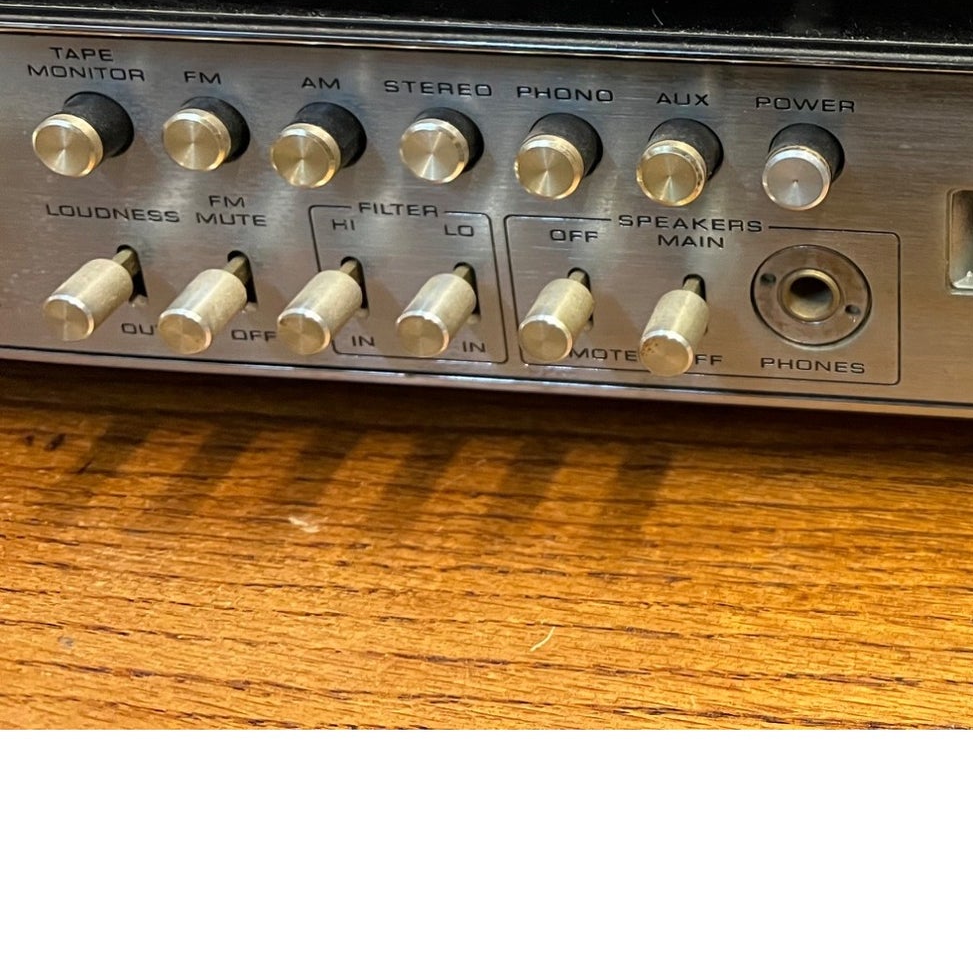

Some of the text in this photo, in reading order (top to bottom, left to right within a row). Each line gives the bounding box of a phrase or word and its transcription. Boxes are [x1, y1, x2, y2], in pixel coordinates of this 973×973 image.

[49, 46, 114, 63] TAPE
[27, 64, 146, 82] MONITOR
[183, 70, 222, 85] FM
[301, 76, 341, 91] AM
[384, 80, 493, 98] STEREO
[516, 86, 614, 103] PHONO
[656, 92, 710, 107] AUX
[755, 96, 856, 113] POWER
[209, 194, 246, 208] FM
[45, 203, 181, 223] LOUDNESS
[358, 202, 439, 217] FILTER
[196, 211, 268, 227] MUTE
[332, 219, 356, 231] HI
[618, 214, 763, 232] SPEAKERS
[444, 224, 475, 237] LO
[550, 229, 599, 243] OFF
[657, 234, 725, 249] MAIN
[121, 322, 157, 336] OU
[231, 328, 278, 342] OFF
[351, 335, 375, 347] IN
[462, 340, 487, 353] IN
[568, 347, 637, 362] MOTE
[694, 354, 724, 366] FF
[760, 357, 866, 374] PHONES
